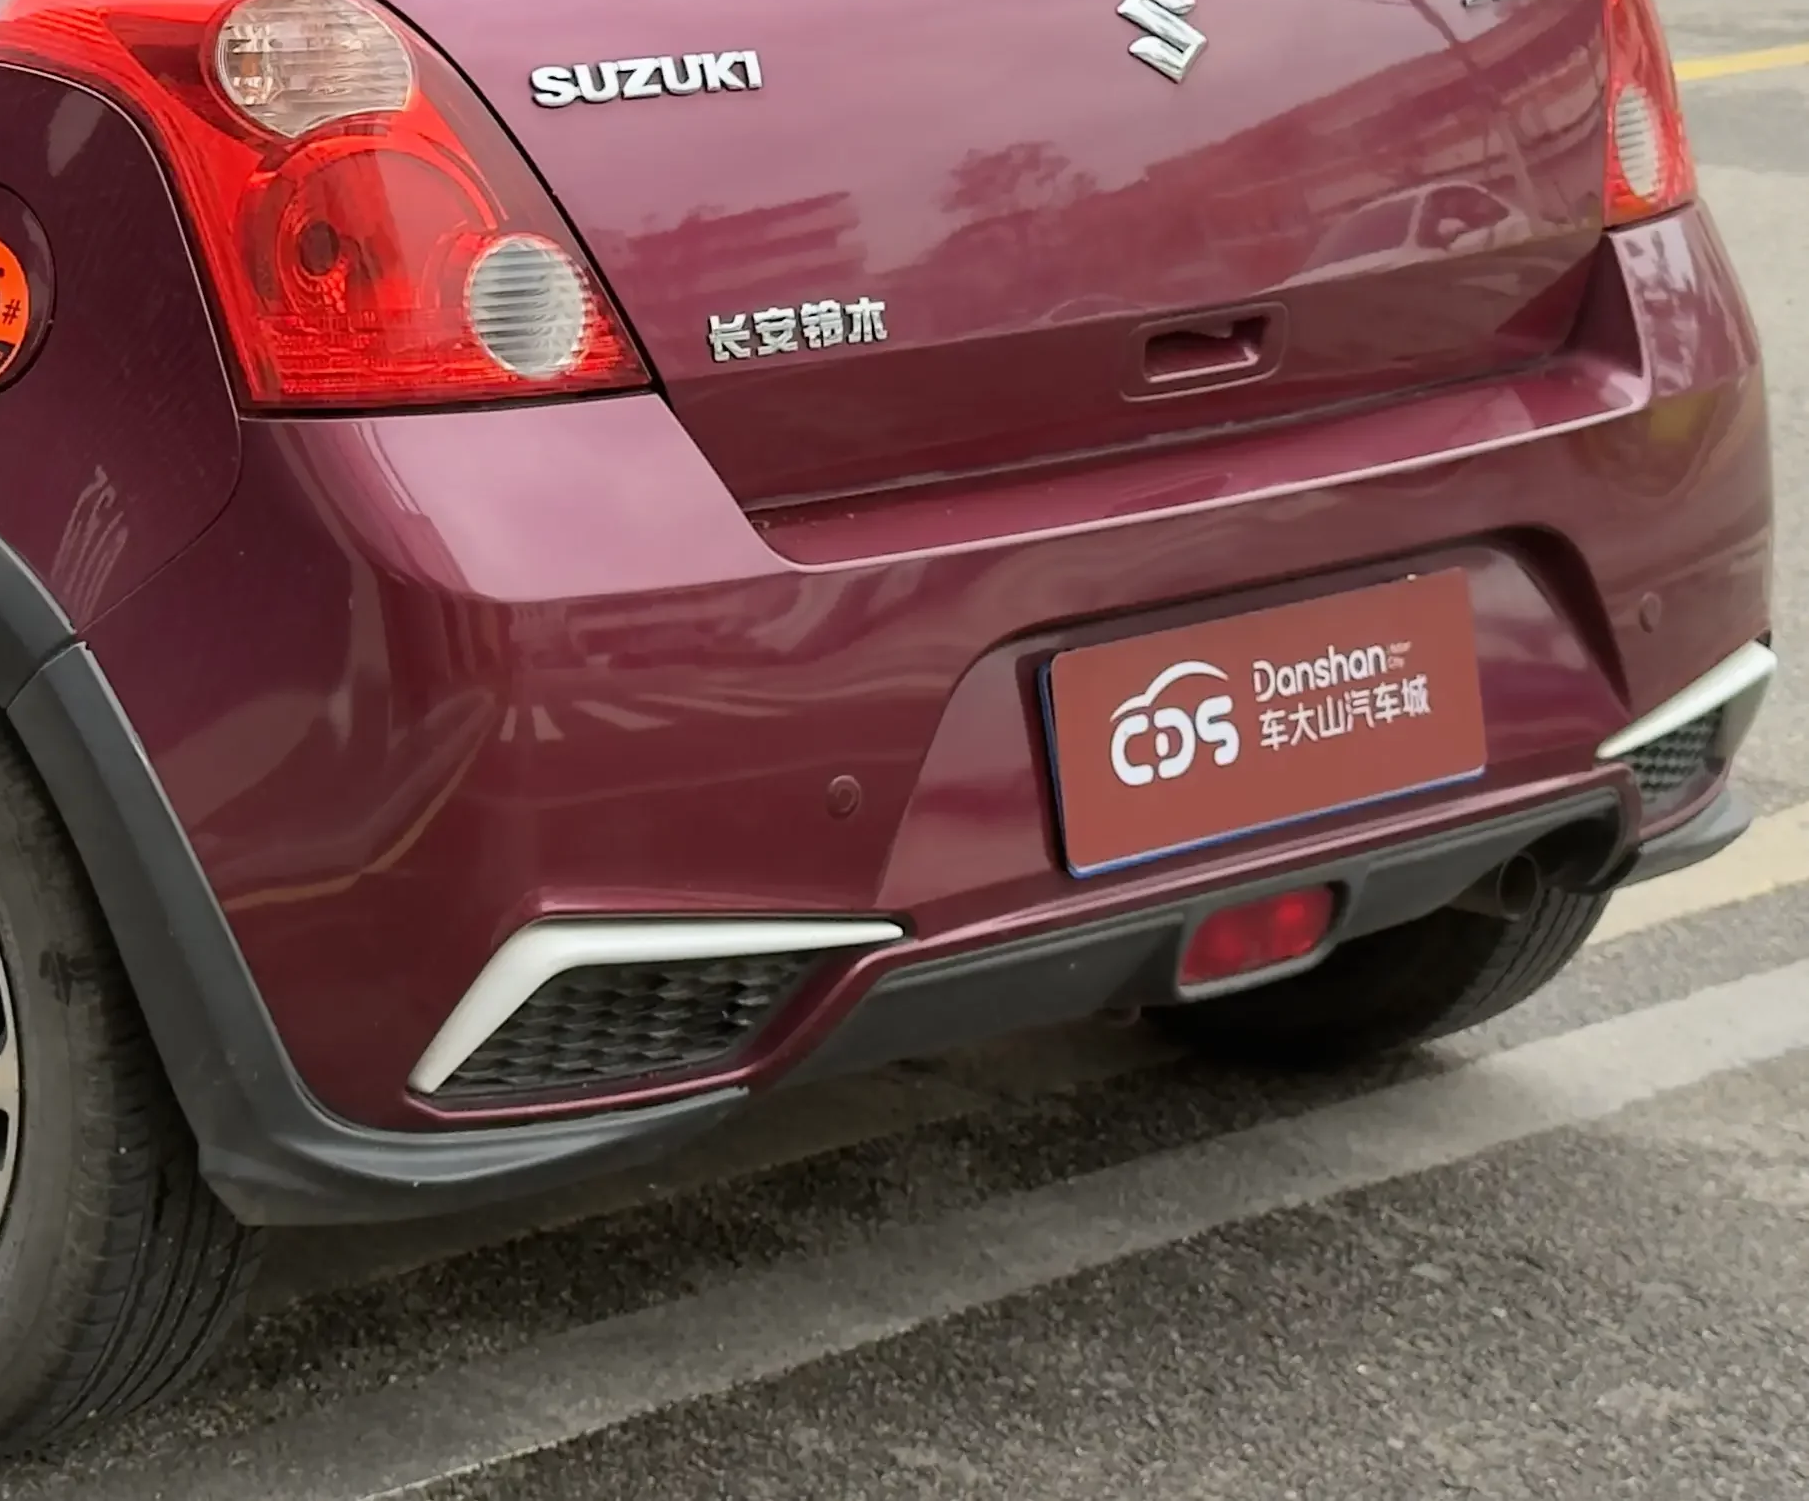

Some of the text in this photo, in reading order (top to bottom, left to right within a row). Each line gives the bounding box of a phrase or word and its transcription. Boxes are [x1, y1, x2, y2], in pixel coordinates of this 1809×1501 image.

[529, 50, 763, 108] SUZUKI
[708, 296, 888, 363] 长安铃木
[1253, 645, 1388, 702] Danshan
[1110, 694, 1240, 787] CDS
[1259, 674, 1431, 750] 车大山汽车城
